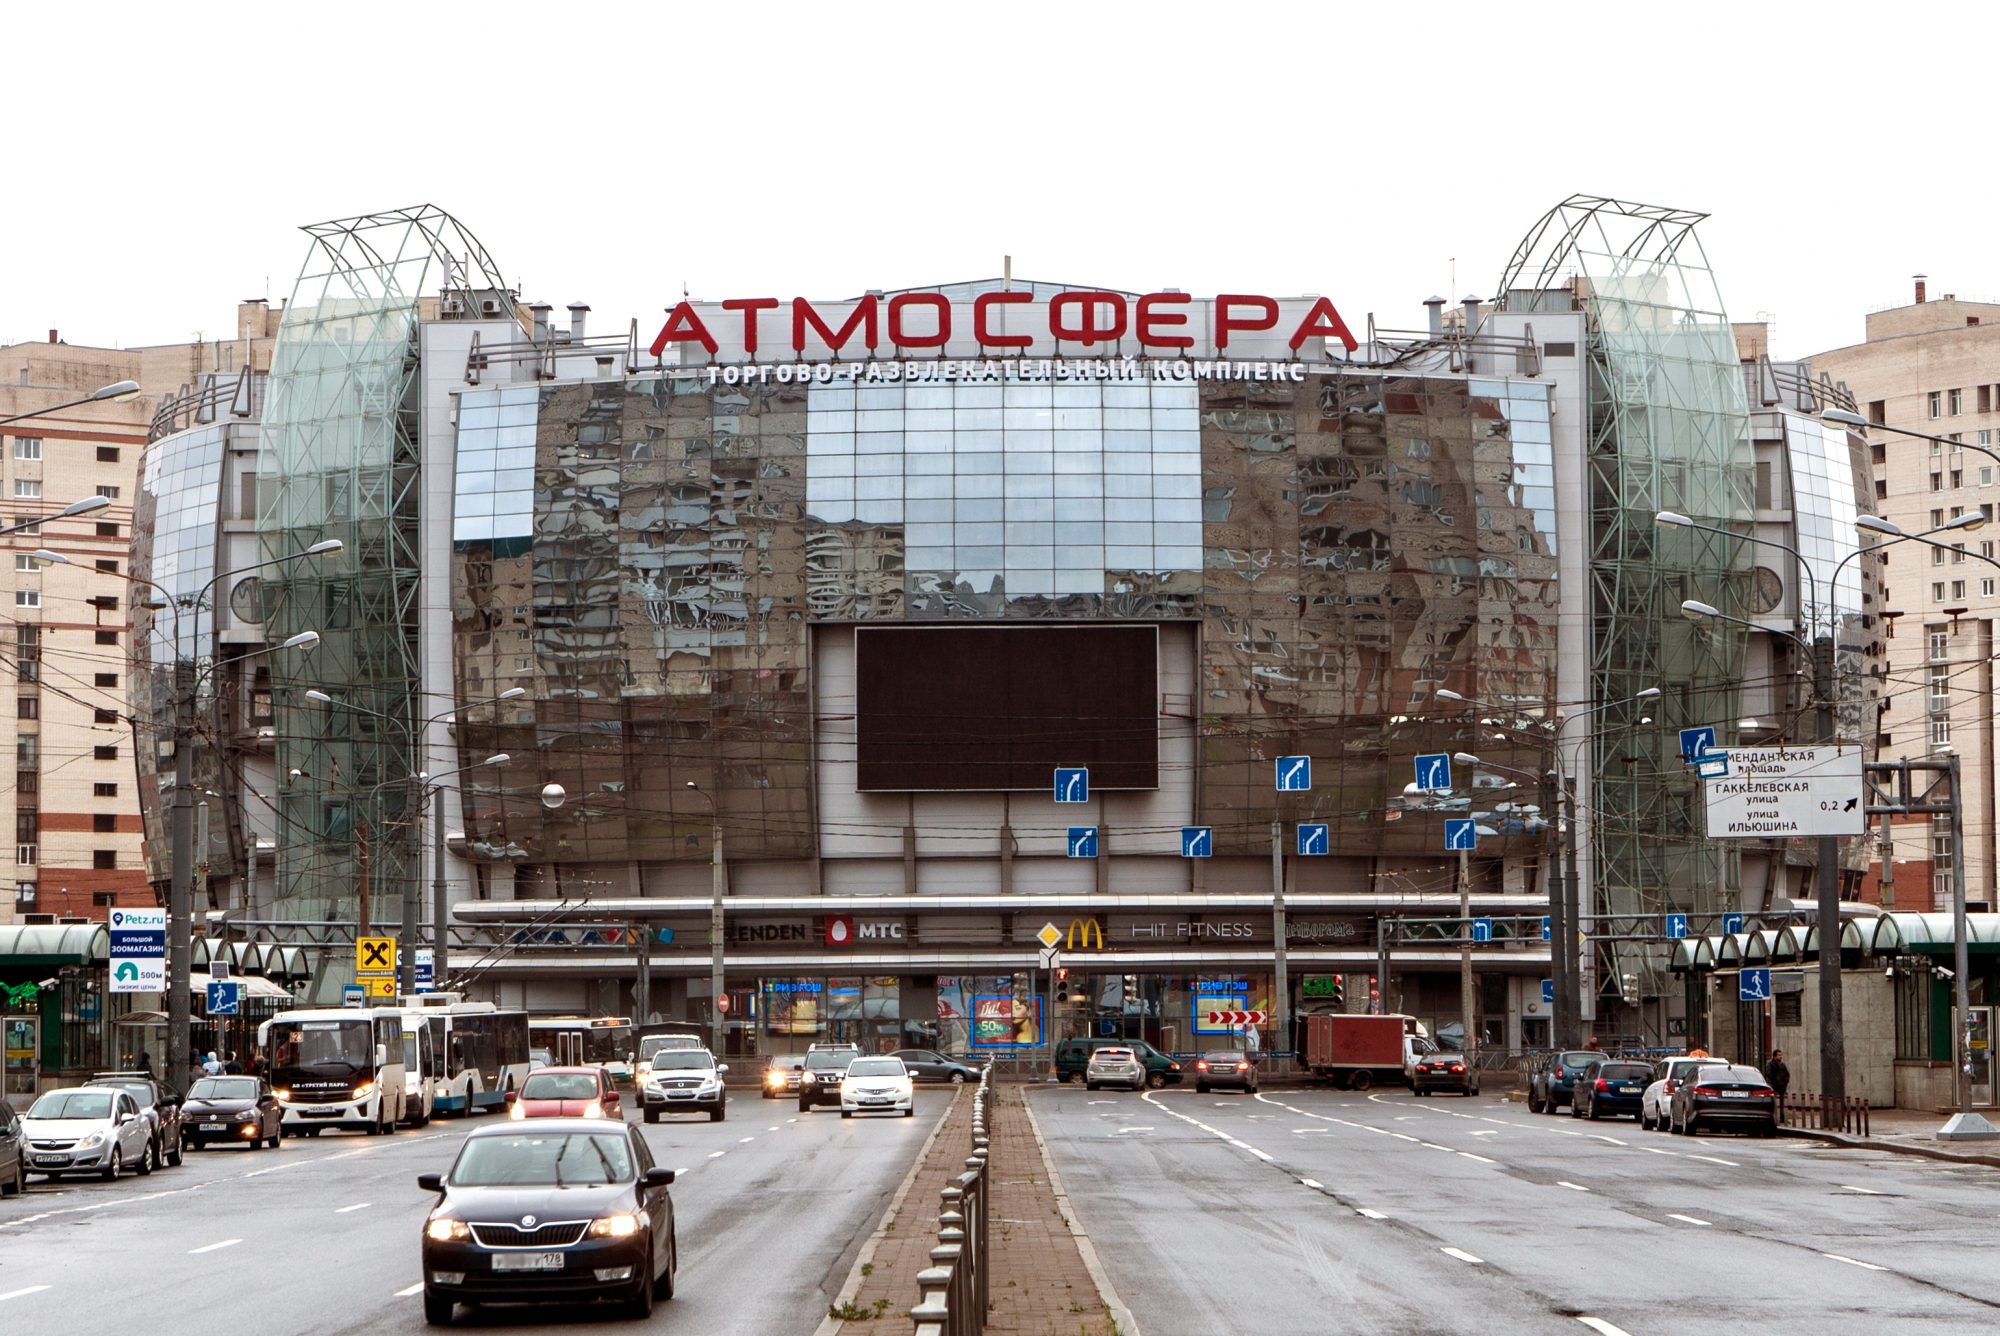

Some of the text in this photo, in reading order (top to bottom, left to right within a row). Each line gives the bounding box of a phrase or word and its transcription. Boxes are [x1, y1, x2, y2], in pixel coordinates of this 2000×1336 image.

[649, 292, 1358, 357] АТМОСФЕРА
[707, 355, 1305, 385] ТОРГОВО-РАЗВЛЕКАТЕЛЬНЫЙ КОМПЛЕКС
[1726, 751, 1815, 763] МЕНДАНТСКАЯ
[1715, 782, 1809, 794] ГАККЕЛЕВСКАЯ
[1746, 795, 1779, 805] улица
[1820, 801, 1839, 812] 0,2
[1746, 810, 1779, 820] улица
[1728, 821, 1798, 833] ИЛЬЮШИНА
[125, 914, 164, 924] Petz.ru
[858, 922, 902, 939] МТС
[1177, 923, 1253, 937] FITNESS
[140, 971, 163, 979] 500м
[543, 1253, 561, 1263] 178
